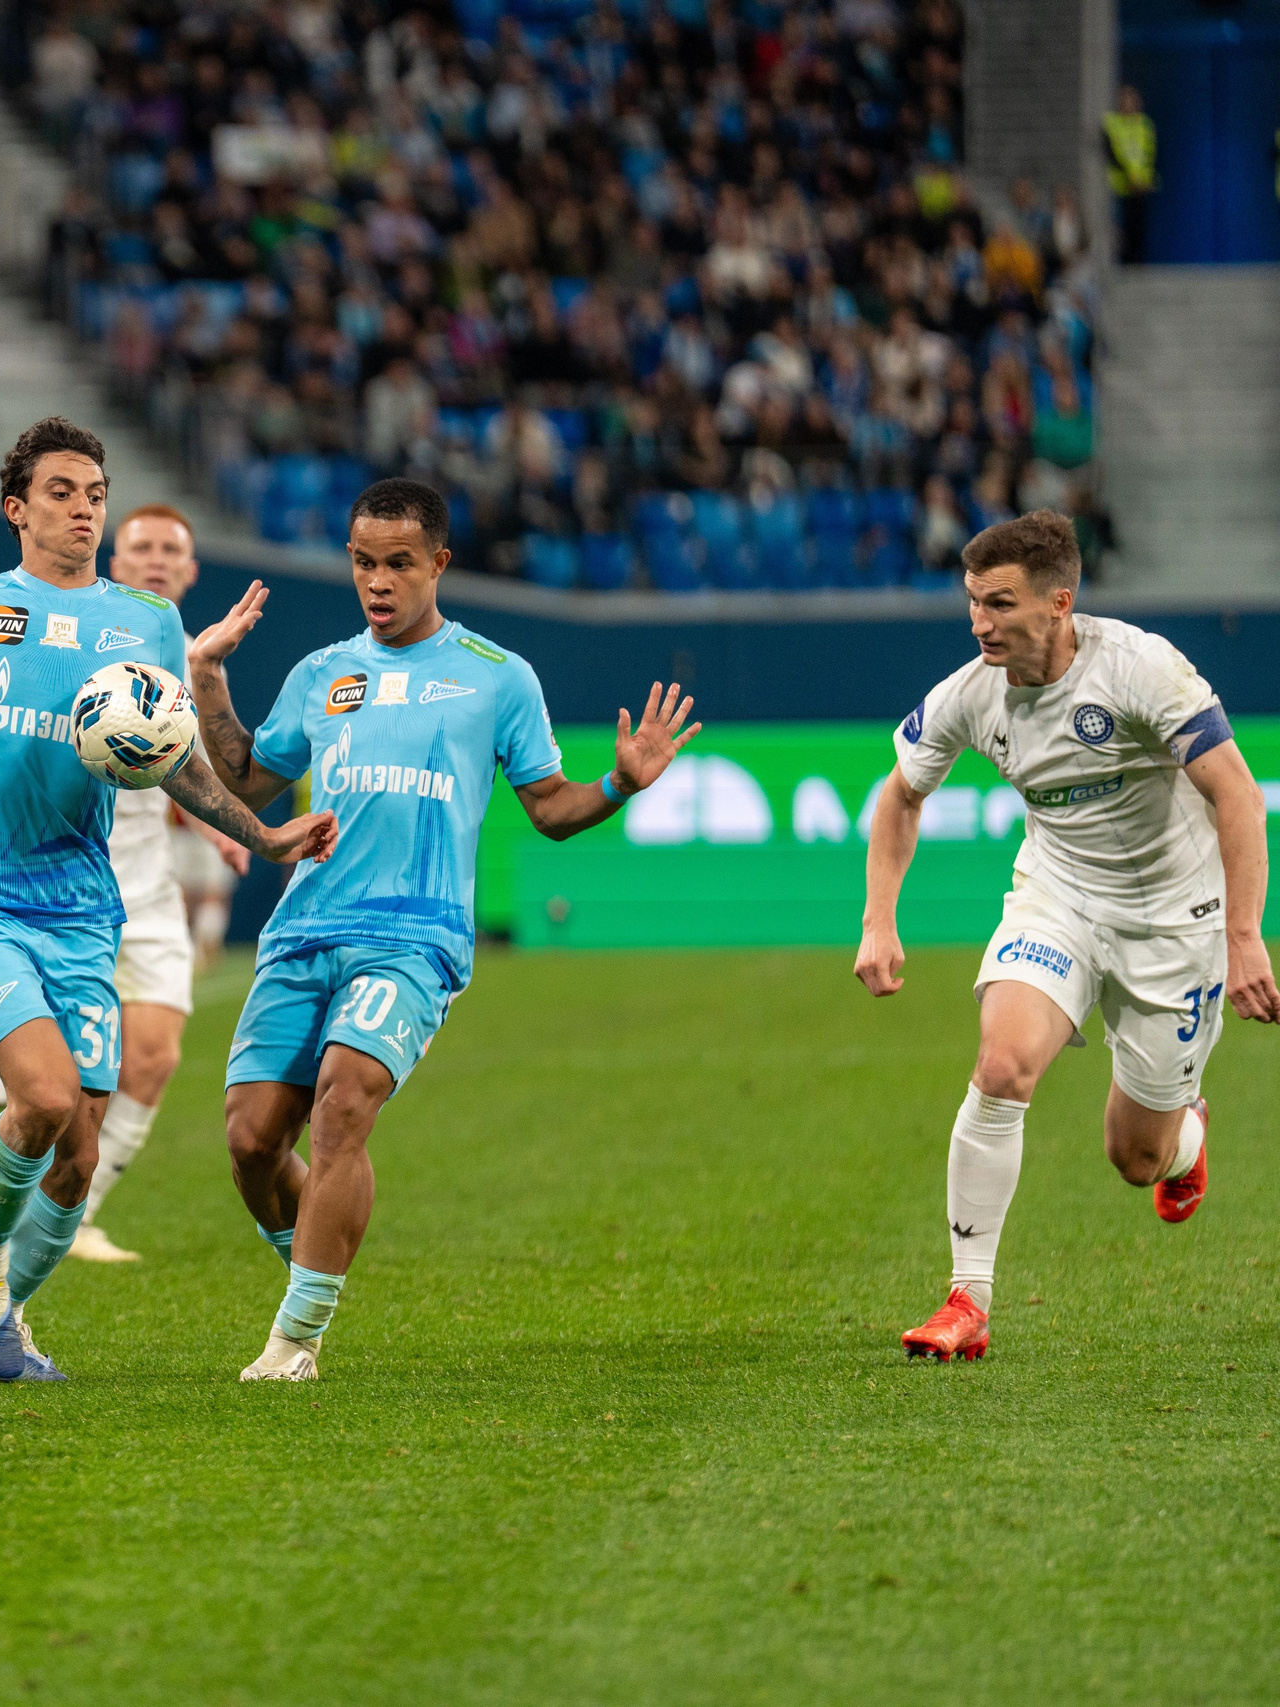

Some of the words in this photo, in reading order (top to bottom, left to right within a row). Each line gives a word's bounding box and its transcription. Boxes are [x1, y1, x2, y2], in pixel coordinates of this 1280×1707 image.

[335, 687, 365, 702] WIN
[10, 706, 74, 745] ГАЗП
[351, 765, 455, 802] ГАЗПРОМ
[1024, 941, 1073, 971] ГАЗПРОМ
[331, 975, 398, 1031] 20
[73, 1005, 119, 1069] 31
